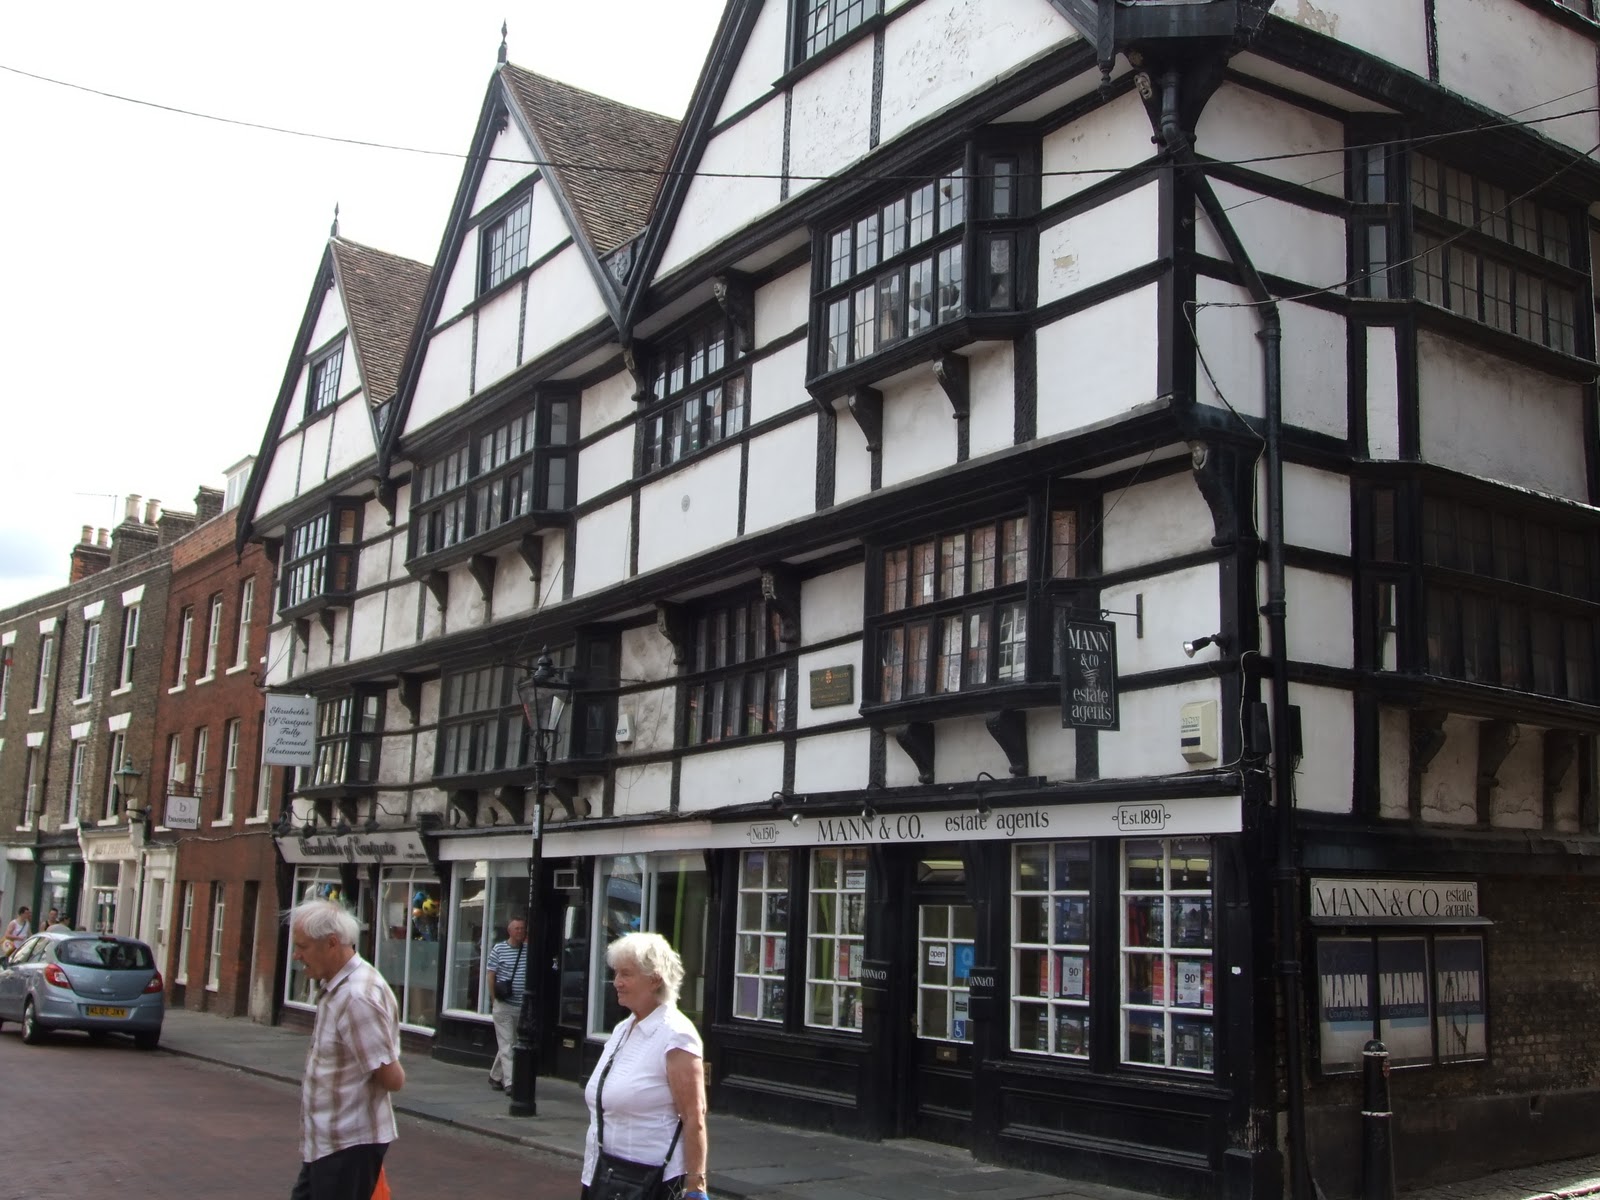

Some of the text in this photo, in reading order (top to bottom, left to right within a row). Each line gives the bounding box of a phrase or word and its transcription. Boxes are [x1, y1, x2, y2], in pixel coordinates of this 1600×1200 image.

[1068, 628, 1109, 652] MANN
[1073, 687, 1109, 704] estate
[269, 706, 310, 716] Elizabeth's
[1072, 704, 1112, 722] agents
[280, 717, 313, 728] Eastgate
[280, 727, 301, 738] Fully
[274, 737, 308, 747] Licensed
[267, 746, 312, 757] Restaurant
[817, 818, 873, 842] MANN
[879, 816, 891, 840] &
[896, 814, 925, 840] CO.
[945, 813, 988, 832] estate
[996, 810, 1050, 837] agents
[1121, 809, 1163, 826] Est.1891
[297, 835, 343, 857] Elizabeth's
[353, 835, 398, 863] Eastgate
[1445, 888, 1473, 902] estate
[1445, 903, 1475, 917] agents
[930, 950, 946, 959] open
[1321, 974, 1369, 1008] MANN
[1379, 971, 1425, 1006] MANN
[1438, 970, 1481, 1002] MANN
